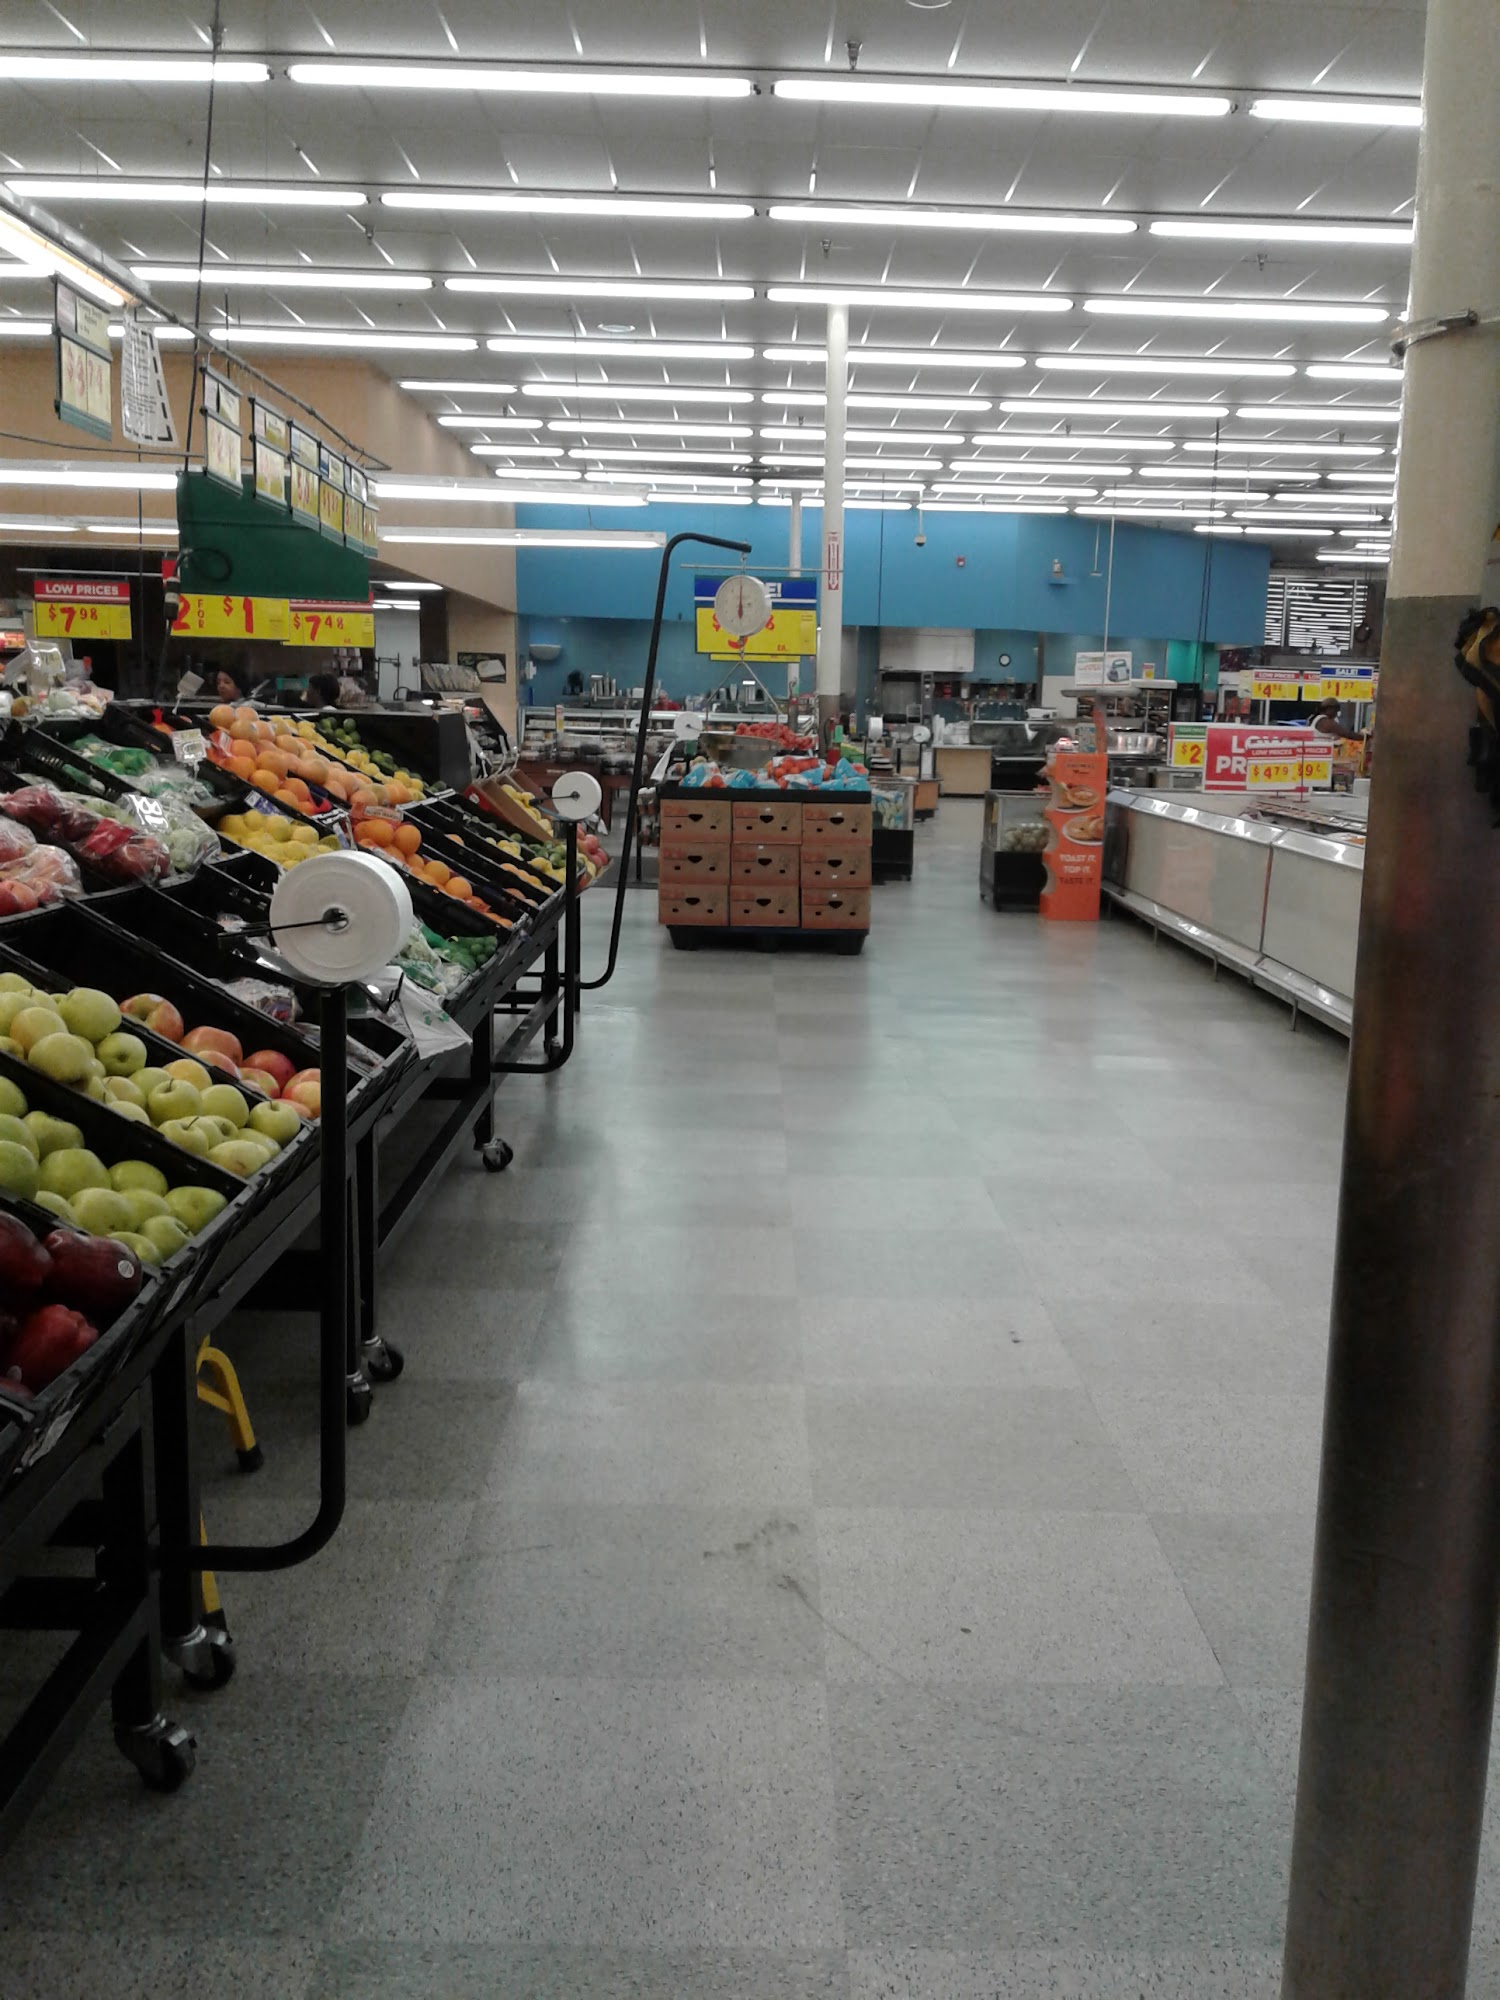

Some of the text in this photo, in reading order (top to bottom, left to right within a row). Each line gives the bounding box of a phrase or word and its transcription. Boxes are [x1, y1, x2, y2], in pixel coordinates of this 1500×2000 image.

[45, 583, 119, 596] LOW PRICES
[172, 594, 191, 631] 2
[197, 599, 205, 629] FOR
[1335, 668, 1359, 676] SALE!
